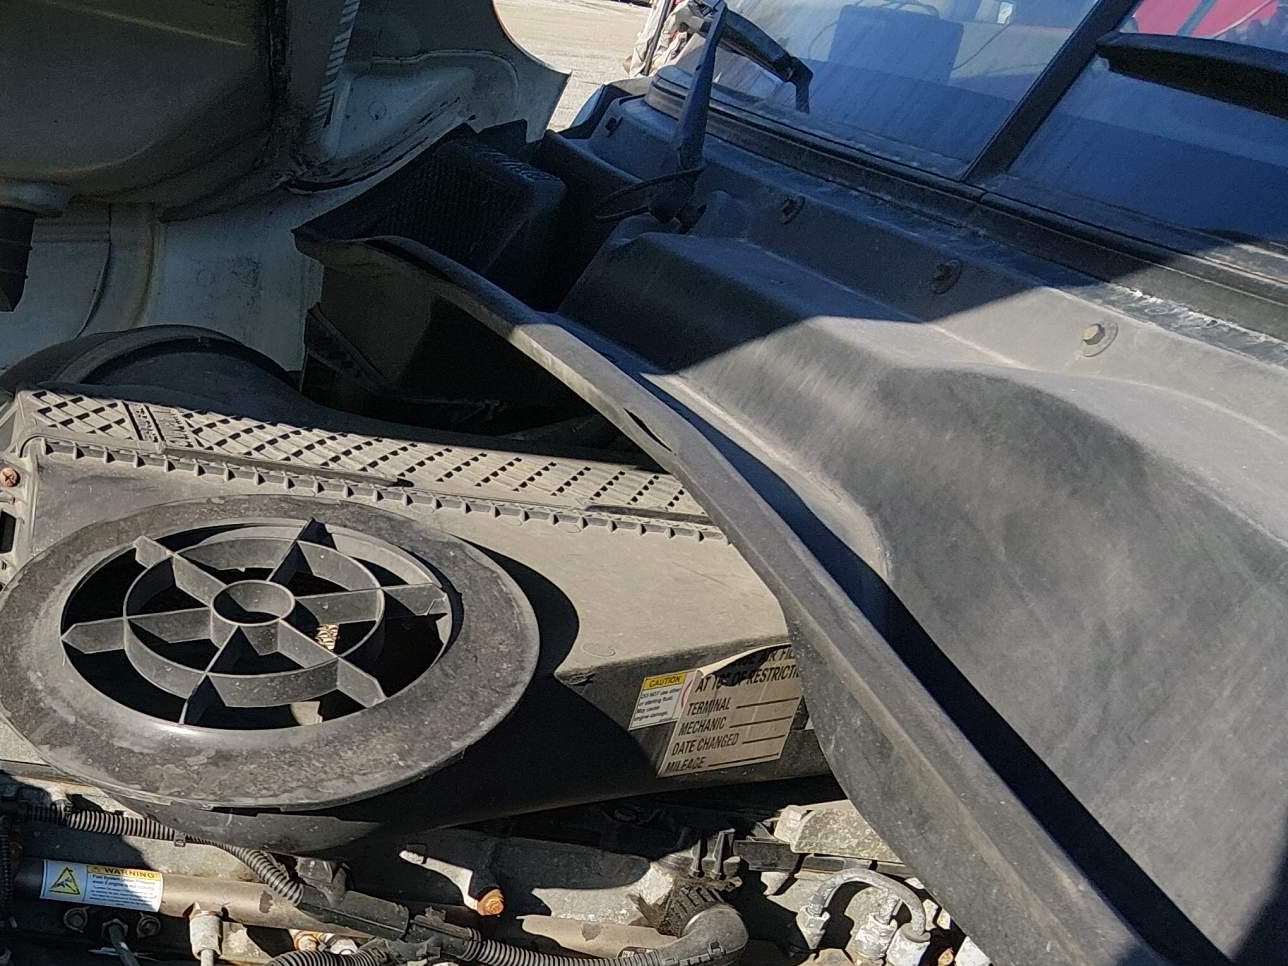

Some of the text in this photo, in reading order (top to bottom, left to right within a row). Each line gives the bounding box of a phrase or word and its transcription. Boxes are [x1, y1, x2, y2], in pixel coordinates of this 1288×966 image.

[648, 675, 681, 688] CAUTION
[695, 677, 710, 693] AT
[687, 697, 731, 716] TERMINAL
[678, 717, 727, 736] MECHANIC
[671, 732, 740, 756] DATE CHANGED
[666, 756, 707, 772] MILEAGE
[104, 867, 155, 879] WARNING
